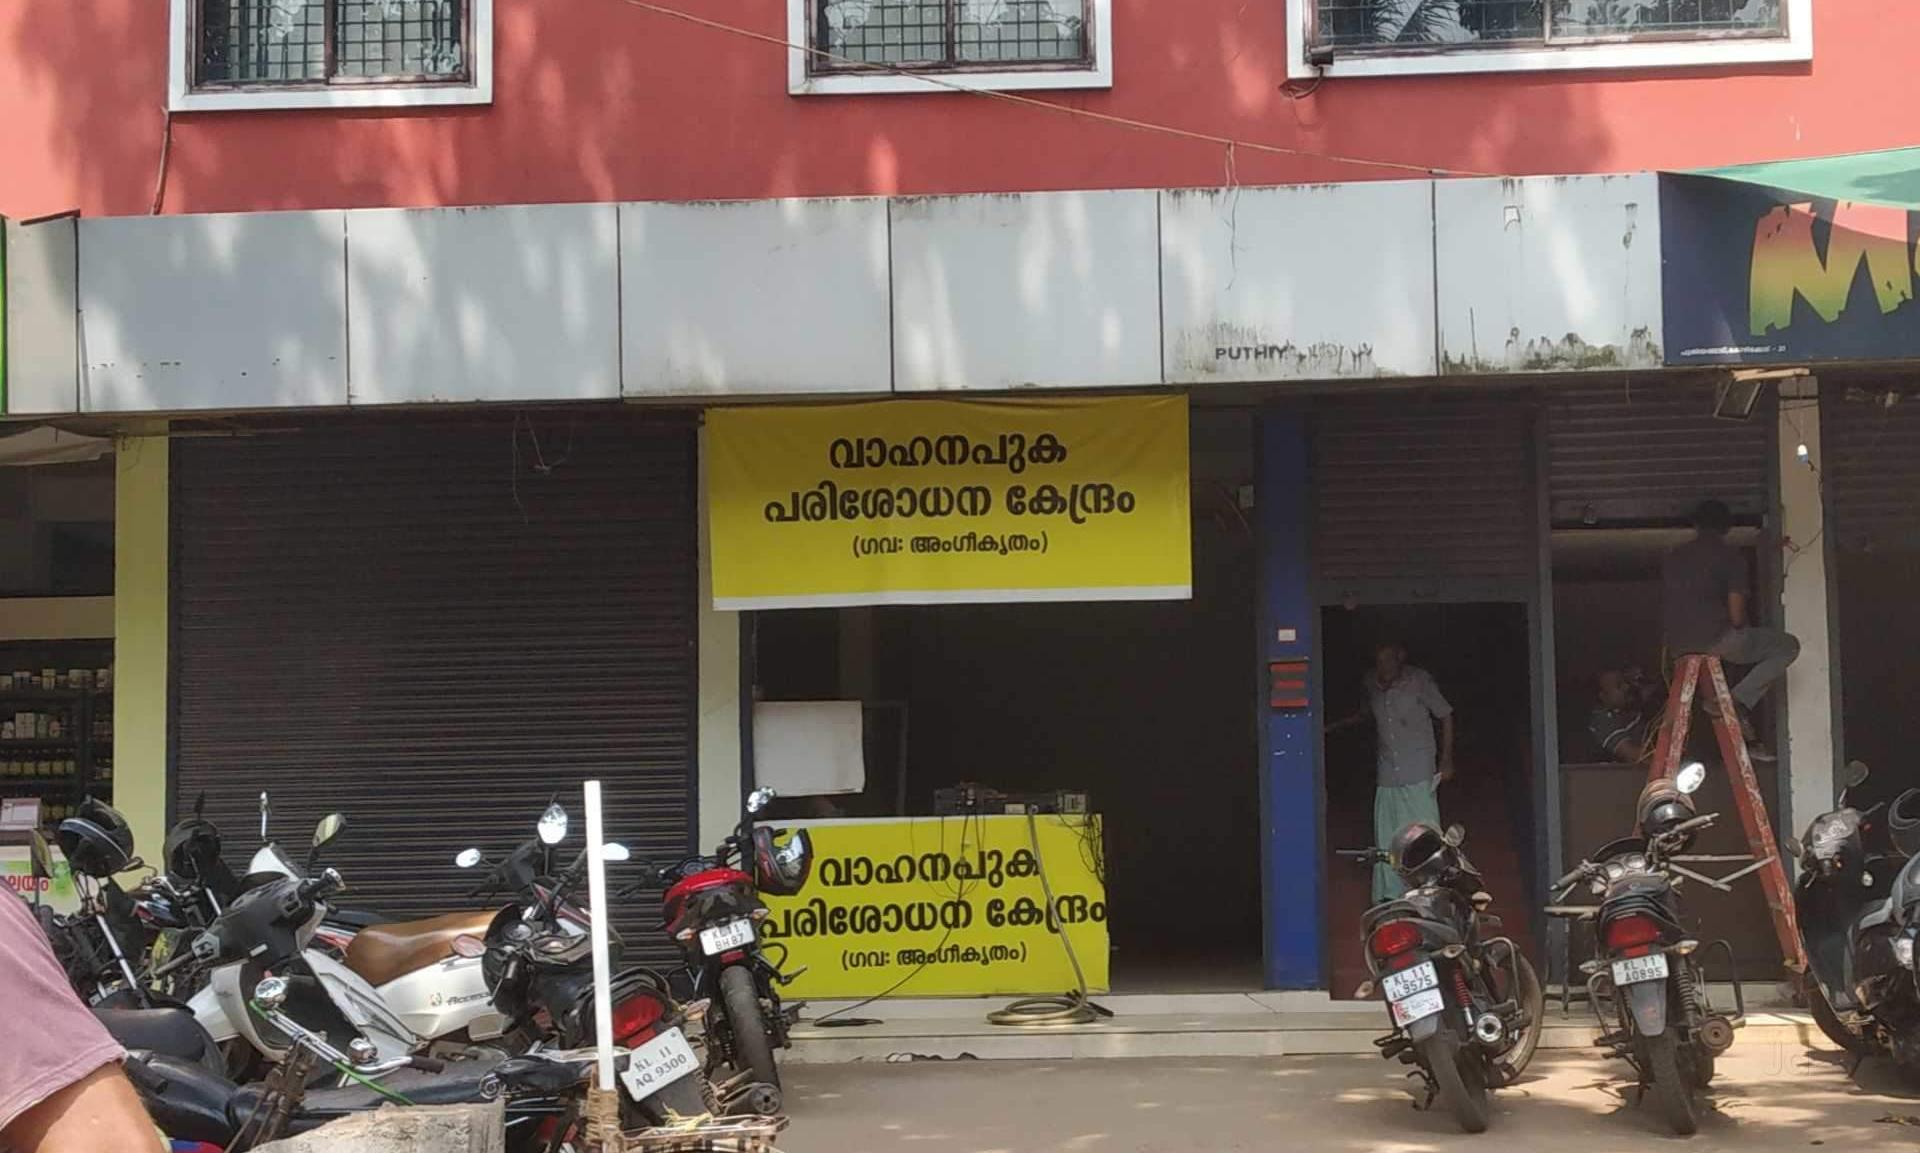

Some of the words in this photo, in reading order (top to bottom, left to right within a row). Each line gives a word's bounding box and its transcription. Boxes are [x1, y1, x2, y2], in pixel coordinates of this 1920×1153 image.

[831, 433, 1067, 474] വാഹനപുക
[764, 480, 992, 523] പരിശോധന
[1005, 482, 1137, 525] കേന്ദ്രം
[818, 848, 1040, 888] വാഹനപുക
[760, 897, 973, 939] പരിശോധന
[986, 893, 1107, 935] കേന്ദ്രം
[1393, 973, 1409, 986] KL
[1411, 966, 1426, 979] 11
[1624, 959, 1639, 971] KL
[1642, 956, 1656, 969] 11
[634, 1057, 653, 1073] KL
[659, 1045, 673, 1059] 11
[634, 1071, 656, 1089] AQ
[655, 1052, 688, 1078] 9300
